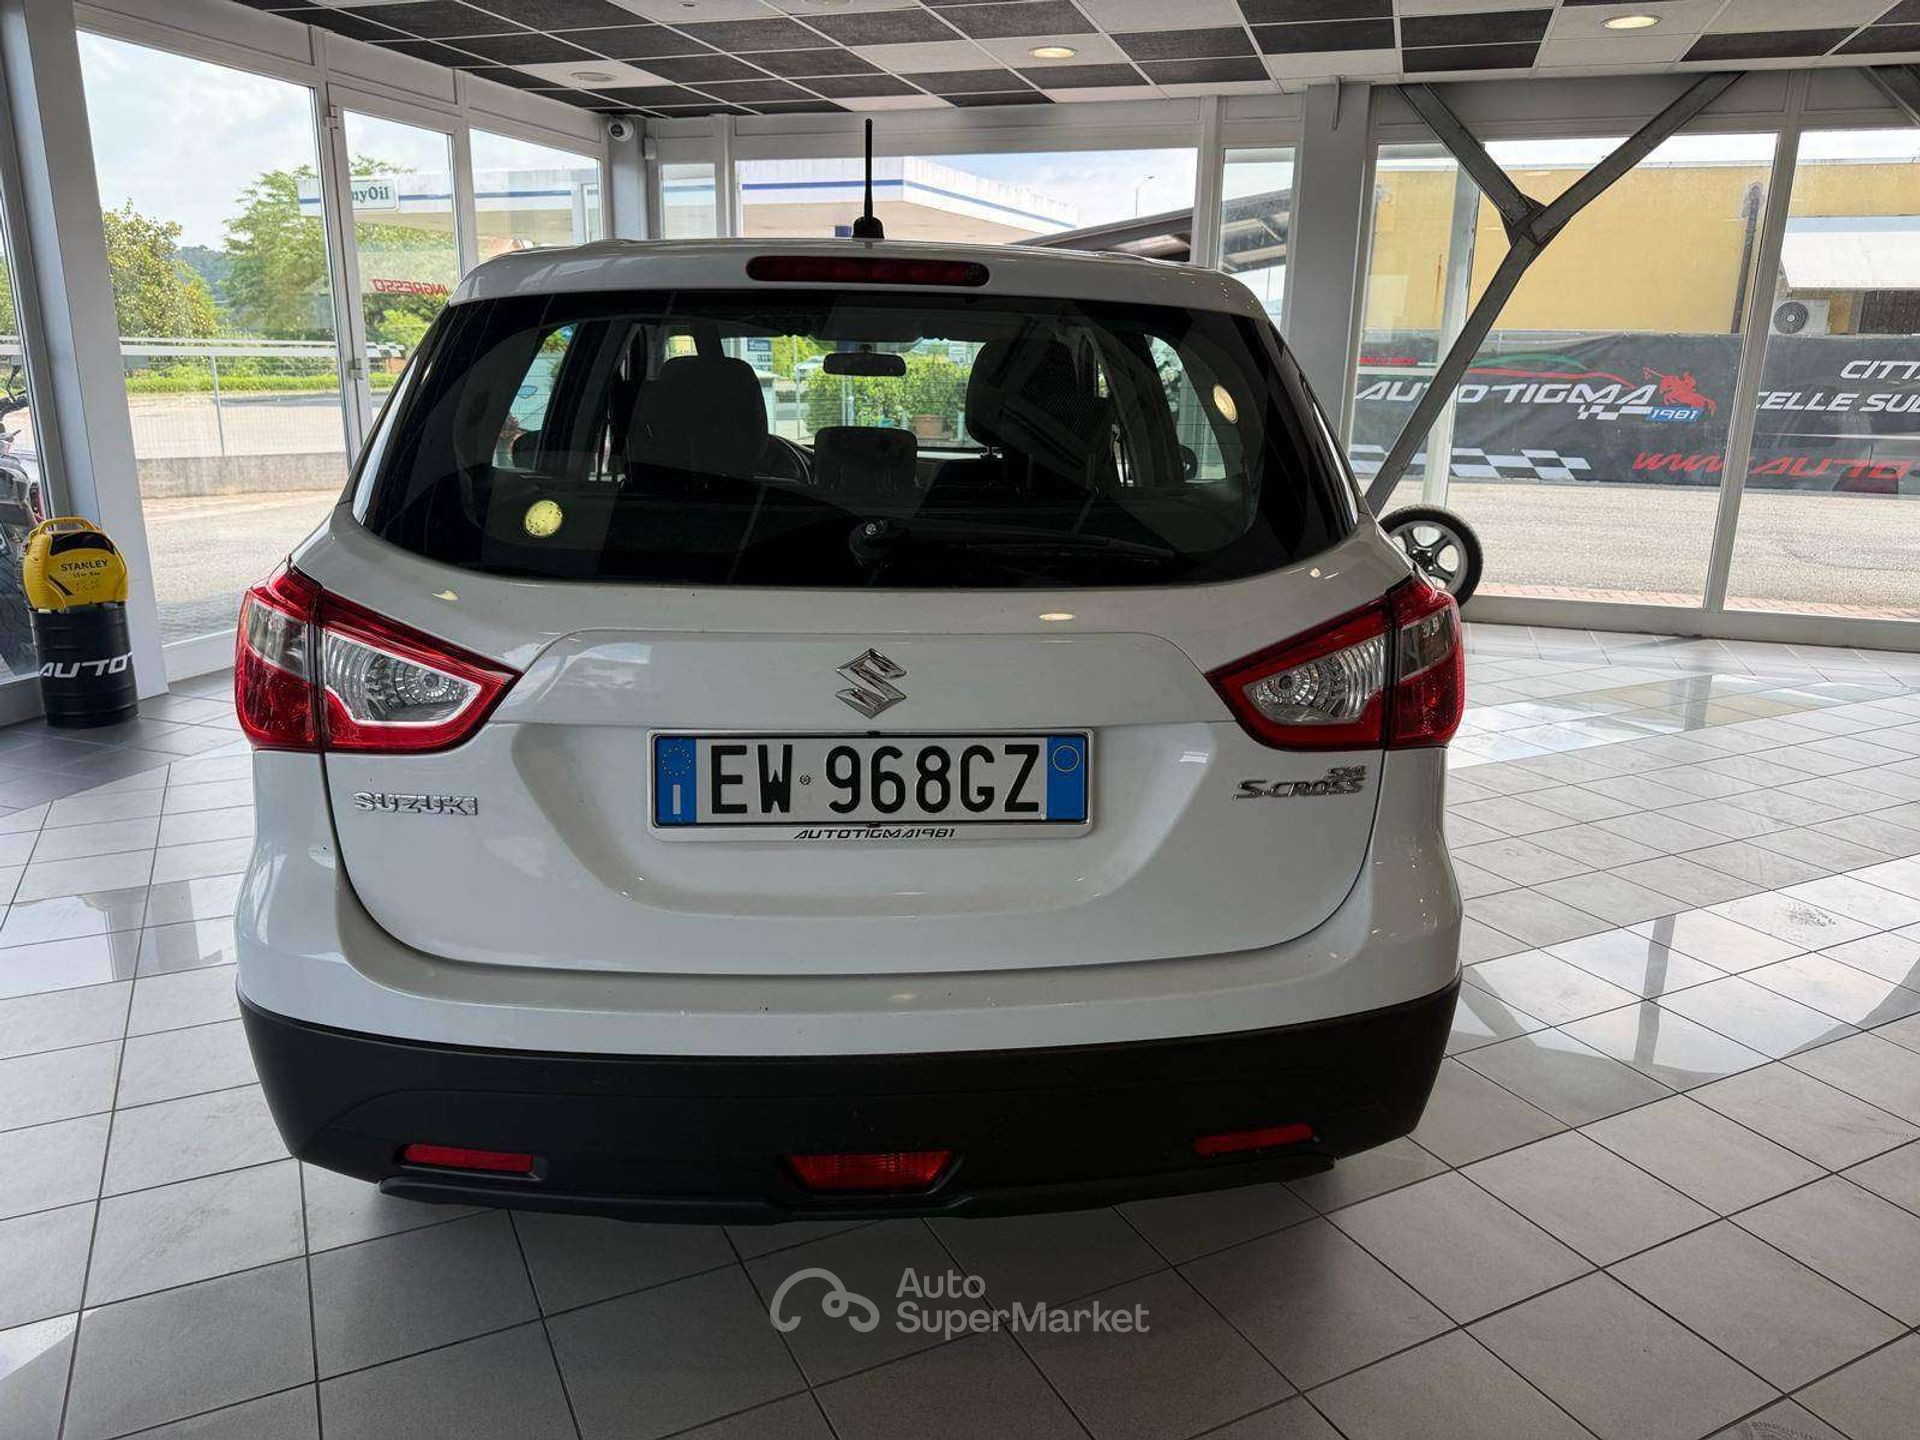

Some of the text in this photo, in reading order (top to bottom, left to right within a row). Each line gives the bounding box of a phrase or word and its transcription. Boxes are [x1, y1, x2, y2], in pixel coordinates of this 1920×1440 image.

[1840, 360, 1920, 379] CITT
[1354, 381, 1658, 405] AUOTIGMA
[1652, 408, 1698, 420] 1981
[61, 559, 108, 572] STANLEY
[39, 652, 133, 679] AUTO
[711, 744, 1040, 815] EW 968GZ
[353, 791, 478, 816] SUZUKI
[794, 828, 955, 840] AUTOTIGMA1981
